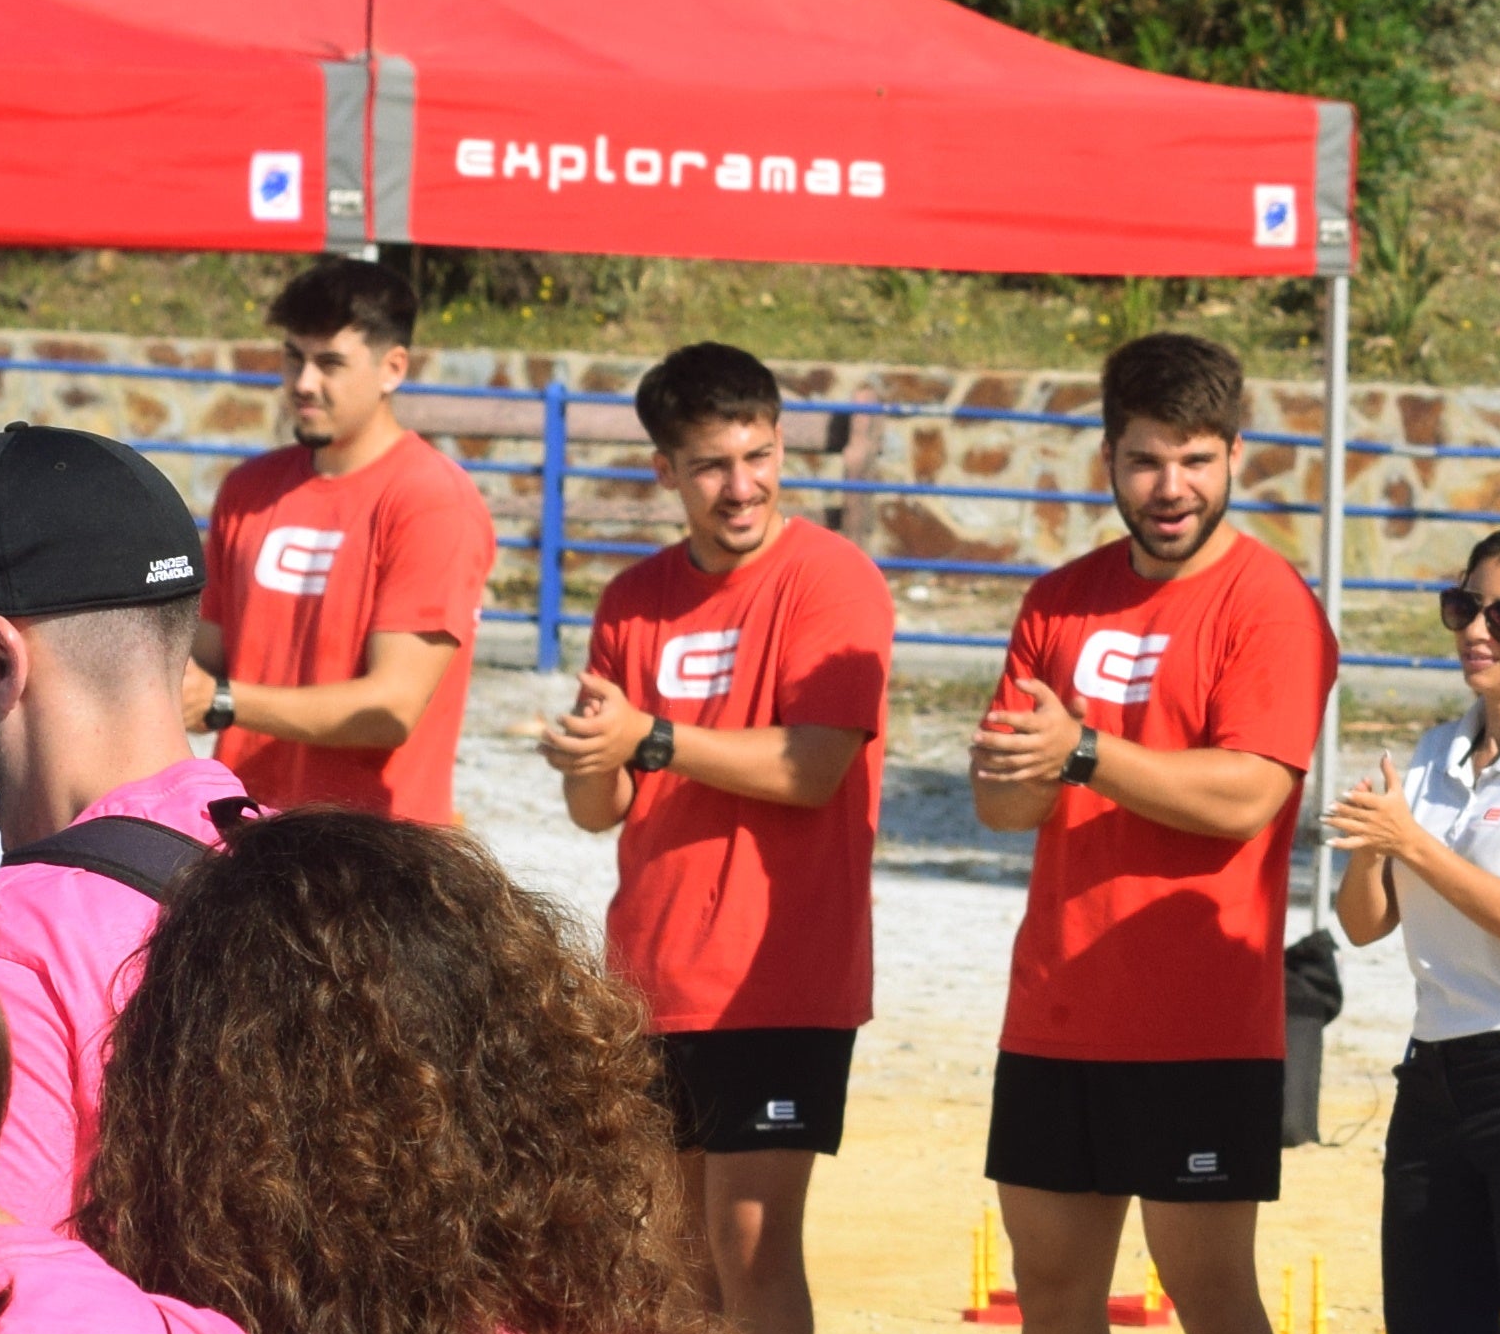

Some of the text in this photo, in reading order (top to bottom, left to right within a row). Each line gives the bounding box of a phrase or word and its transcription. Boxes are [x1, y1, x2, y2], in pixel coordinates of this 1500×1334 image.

[456, 133, 886, 198] exploramas
[149, 555, 189, 572] UNDER
[145, 565, 194, 584] ARMOUR
